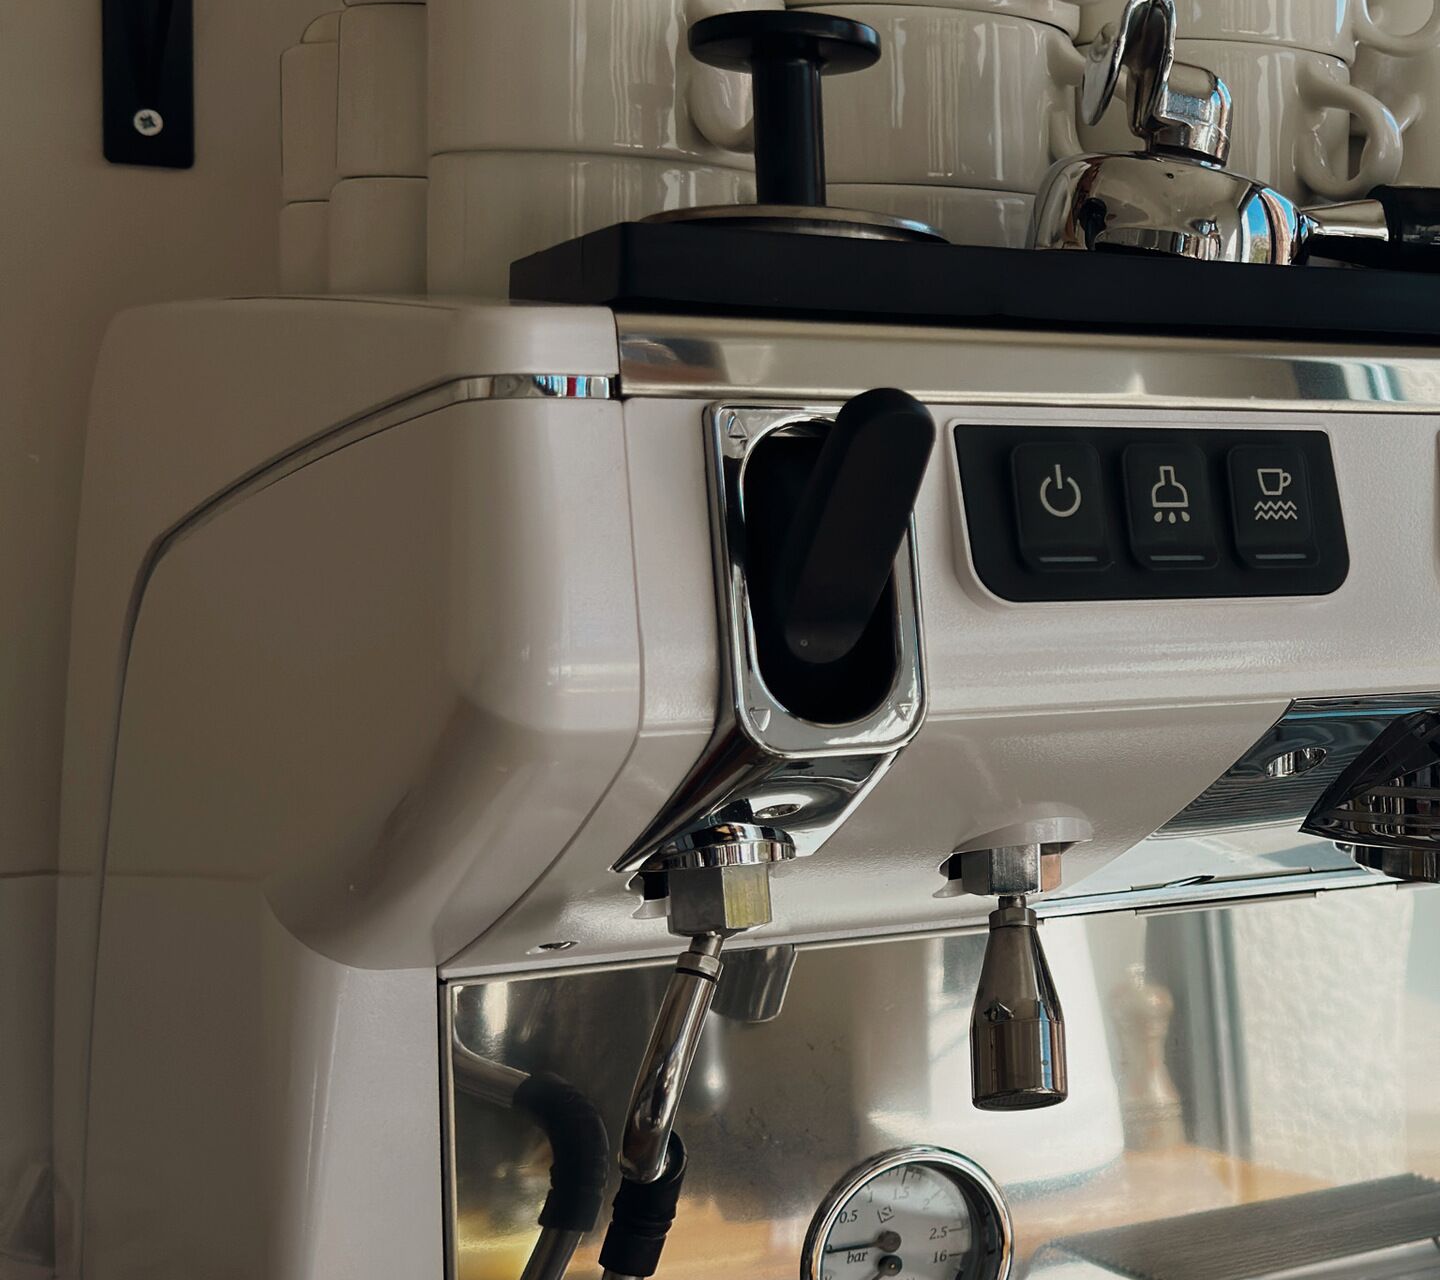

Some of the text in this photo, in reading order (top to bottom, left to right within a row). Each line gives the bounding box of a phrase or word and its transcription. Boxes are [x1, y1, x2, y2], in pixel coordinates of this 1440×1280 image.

[893, 1188, 910, 1200] 1.5
[839, 1209, 858, 1224] 0.5
[928, 1226, 948, 1241] 2.5
[846, 1249, 869, 1265] bar
[933, 1249, 947, 1264] 16
